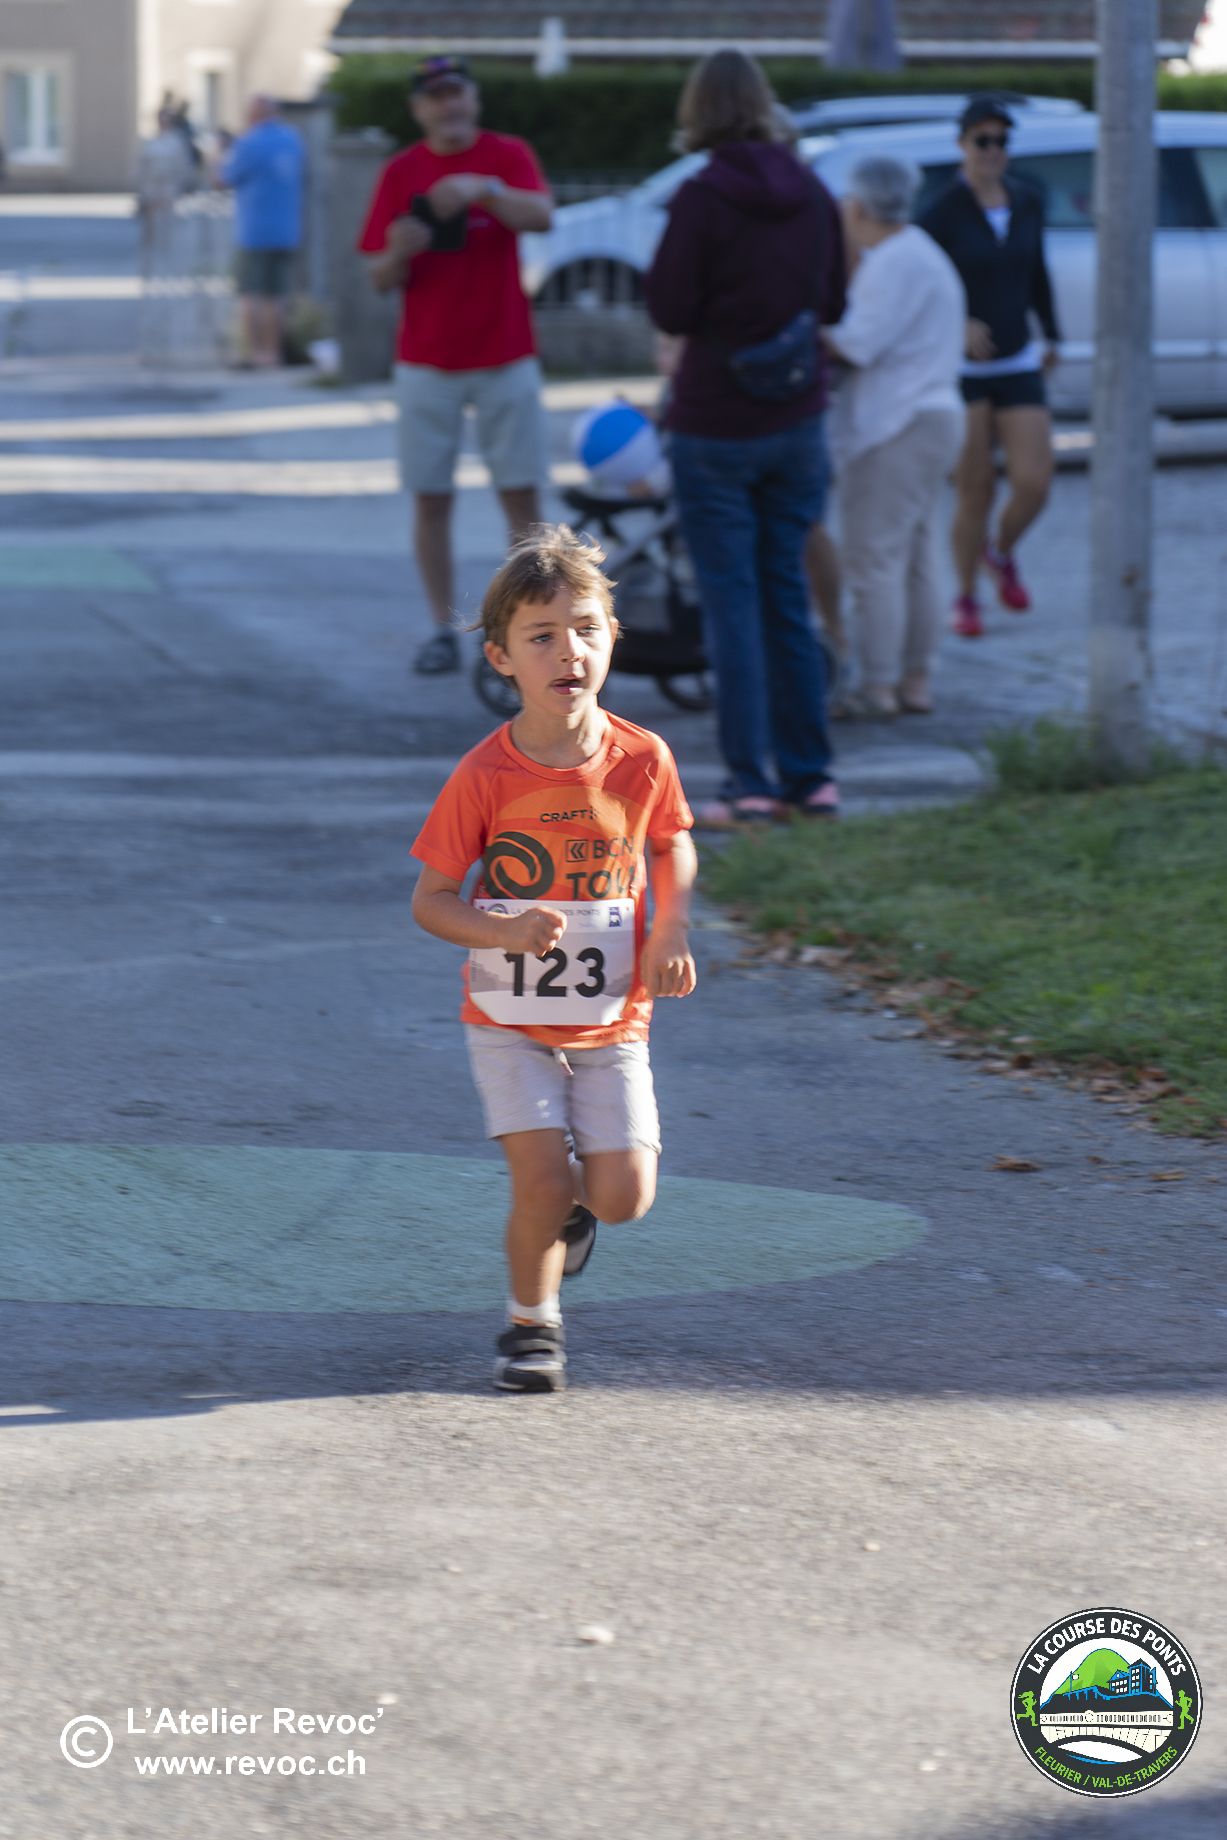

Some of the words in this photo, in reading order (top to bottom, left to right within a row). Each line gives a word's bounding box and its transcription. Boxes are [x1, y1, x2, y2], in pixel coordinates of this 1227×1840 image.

[540, 809, 588, 823] CRAFT
[593, 835, 634, 859] BCN
[504, 946, 605, 998] 123
